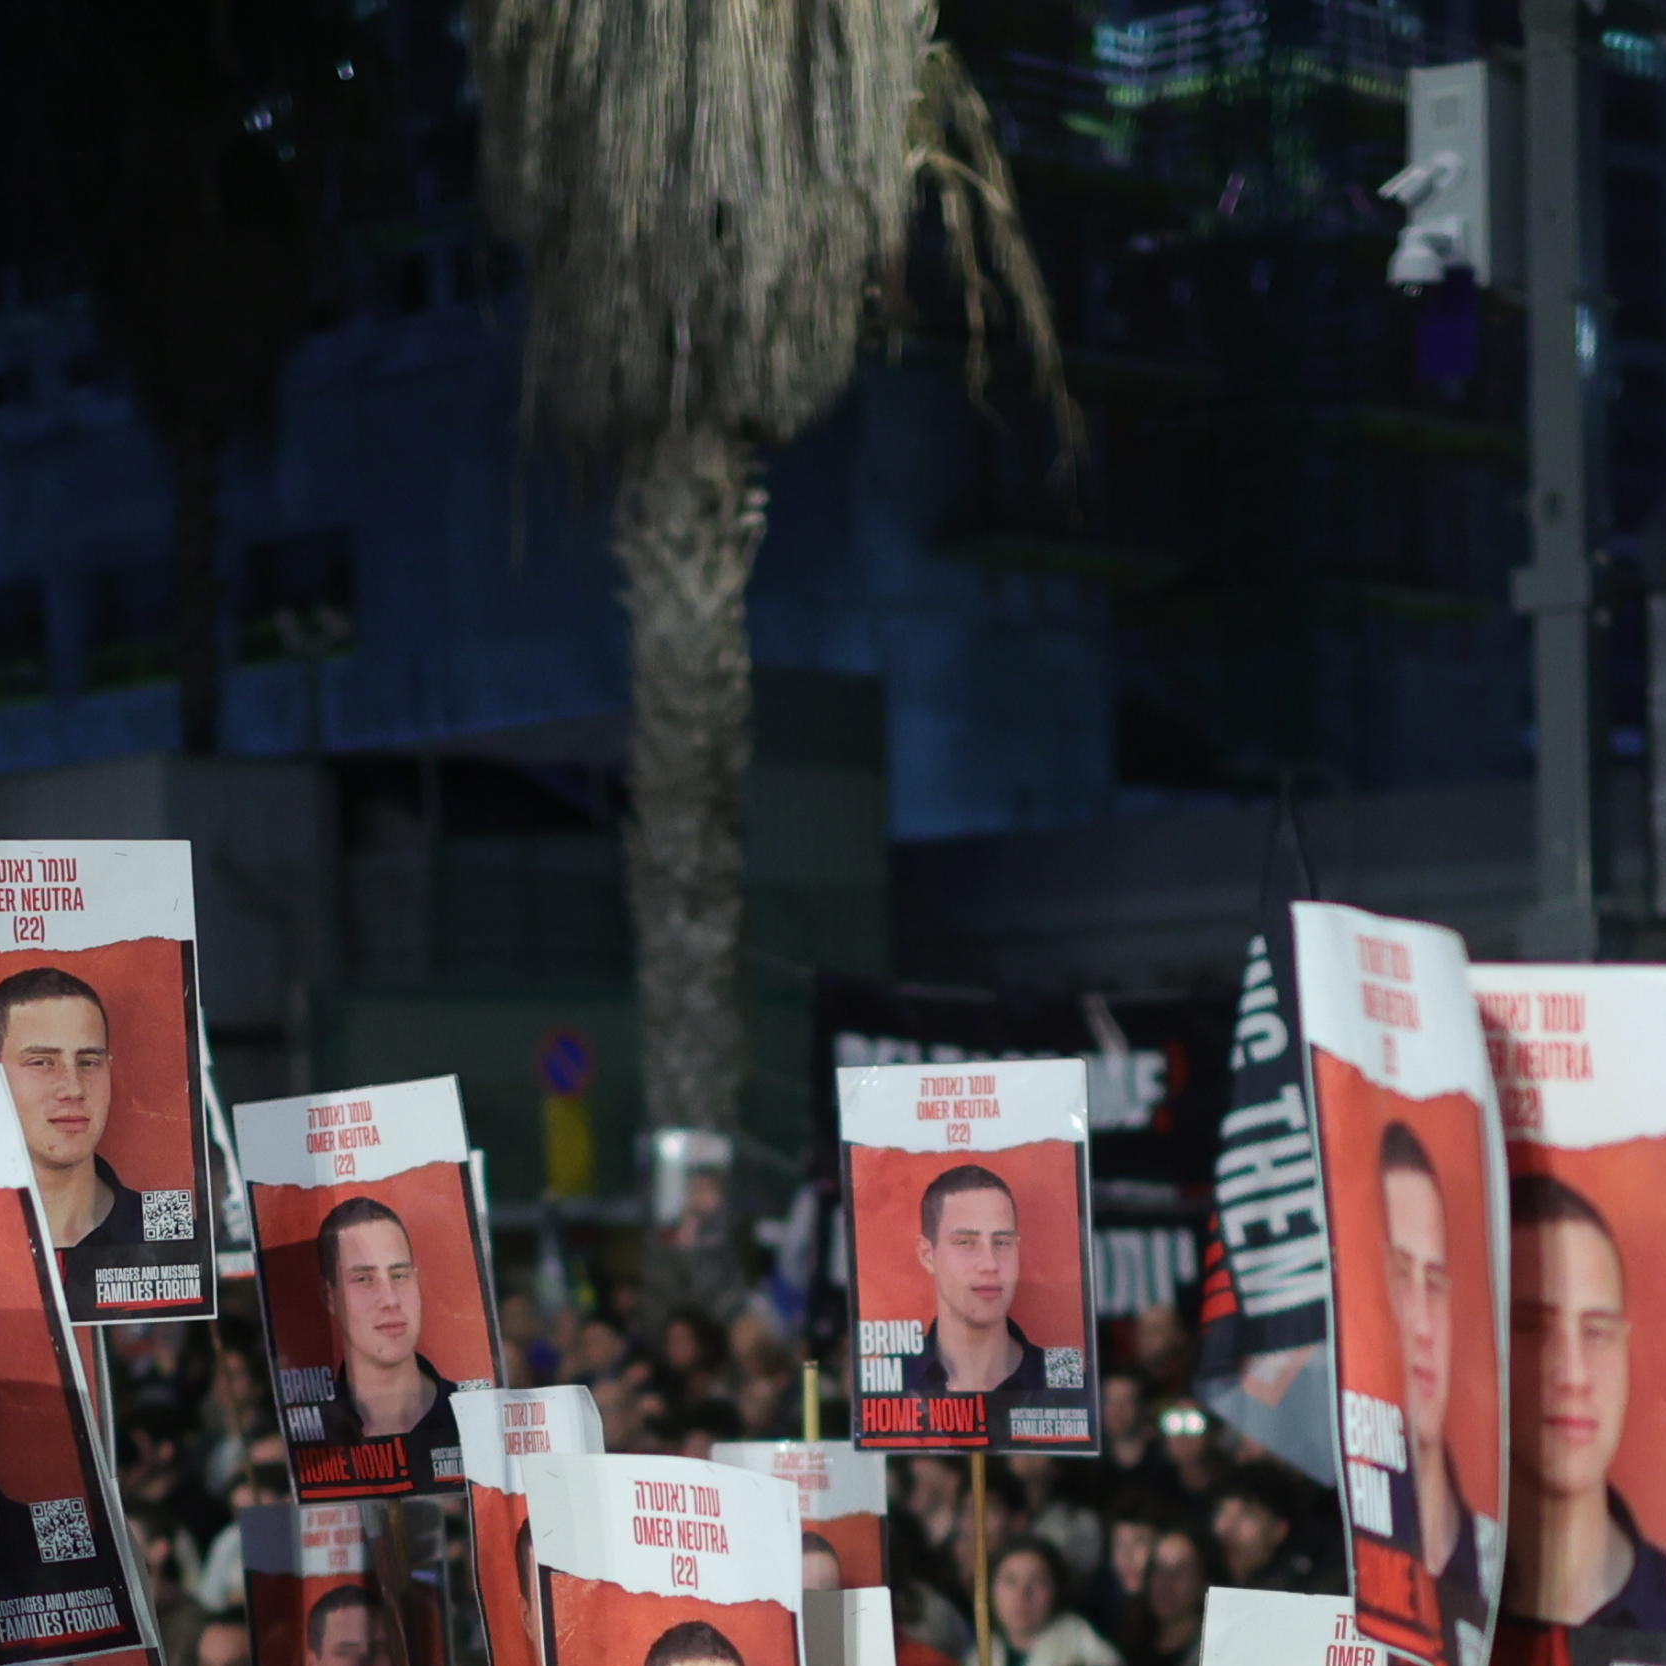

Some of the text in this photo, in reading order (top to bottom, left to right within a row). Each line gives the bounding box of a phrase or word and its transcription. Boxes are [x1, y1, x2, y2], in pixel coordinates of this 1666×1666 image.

[38, 858, 78, 883] עומר
[21, 888, 85, 911] NEUTRA
[12, 916, 45, 942] (22)
[921, 1075, 996, 1097] עומר נאוטרה
[348, 1100, 372, 1122] עומר
[916, 1098, 1001, 1120] OMER NEUTRA
[306, 1124, 381, 1154] OMER NEUTRA
[947, 1123, 971, 1143] (22)
[333, 1153, 356, 1177] (22)
[1213, 1084, 1331, 1320] THEM
[95, 1264, 199, 1283] HOSTAGES AND MISSING
[96, 1278, 201, 1305] FAMILIES FORUM
[859, 1320, 924, 1355] BRING
[280, 1366, 336, 1405] BRING
[861, 1356, 902, 1392] HIM
[287, 1406, 326, 1443] HIM
[862, 1394, 987, 1433] HOME NOW!
[1011, 1419, 1089, 1439] FAMILIES FORUM
[297, 1436, 408, 1484] HOME NOW!
[634, 1481, 721, 1518] עומר נאוטרה
[633, 1516, 730, 1555] OMER NEUTRA
[671, 1555, 699, 1589] (22)
[43, 1593, 65, 1614] AND
[67, 1588, 113, 1611] MISSING
[65, 1604, 121, 1634] FORUM
